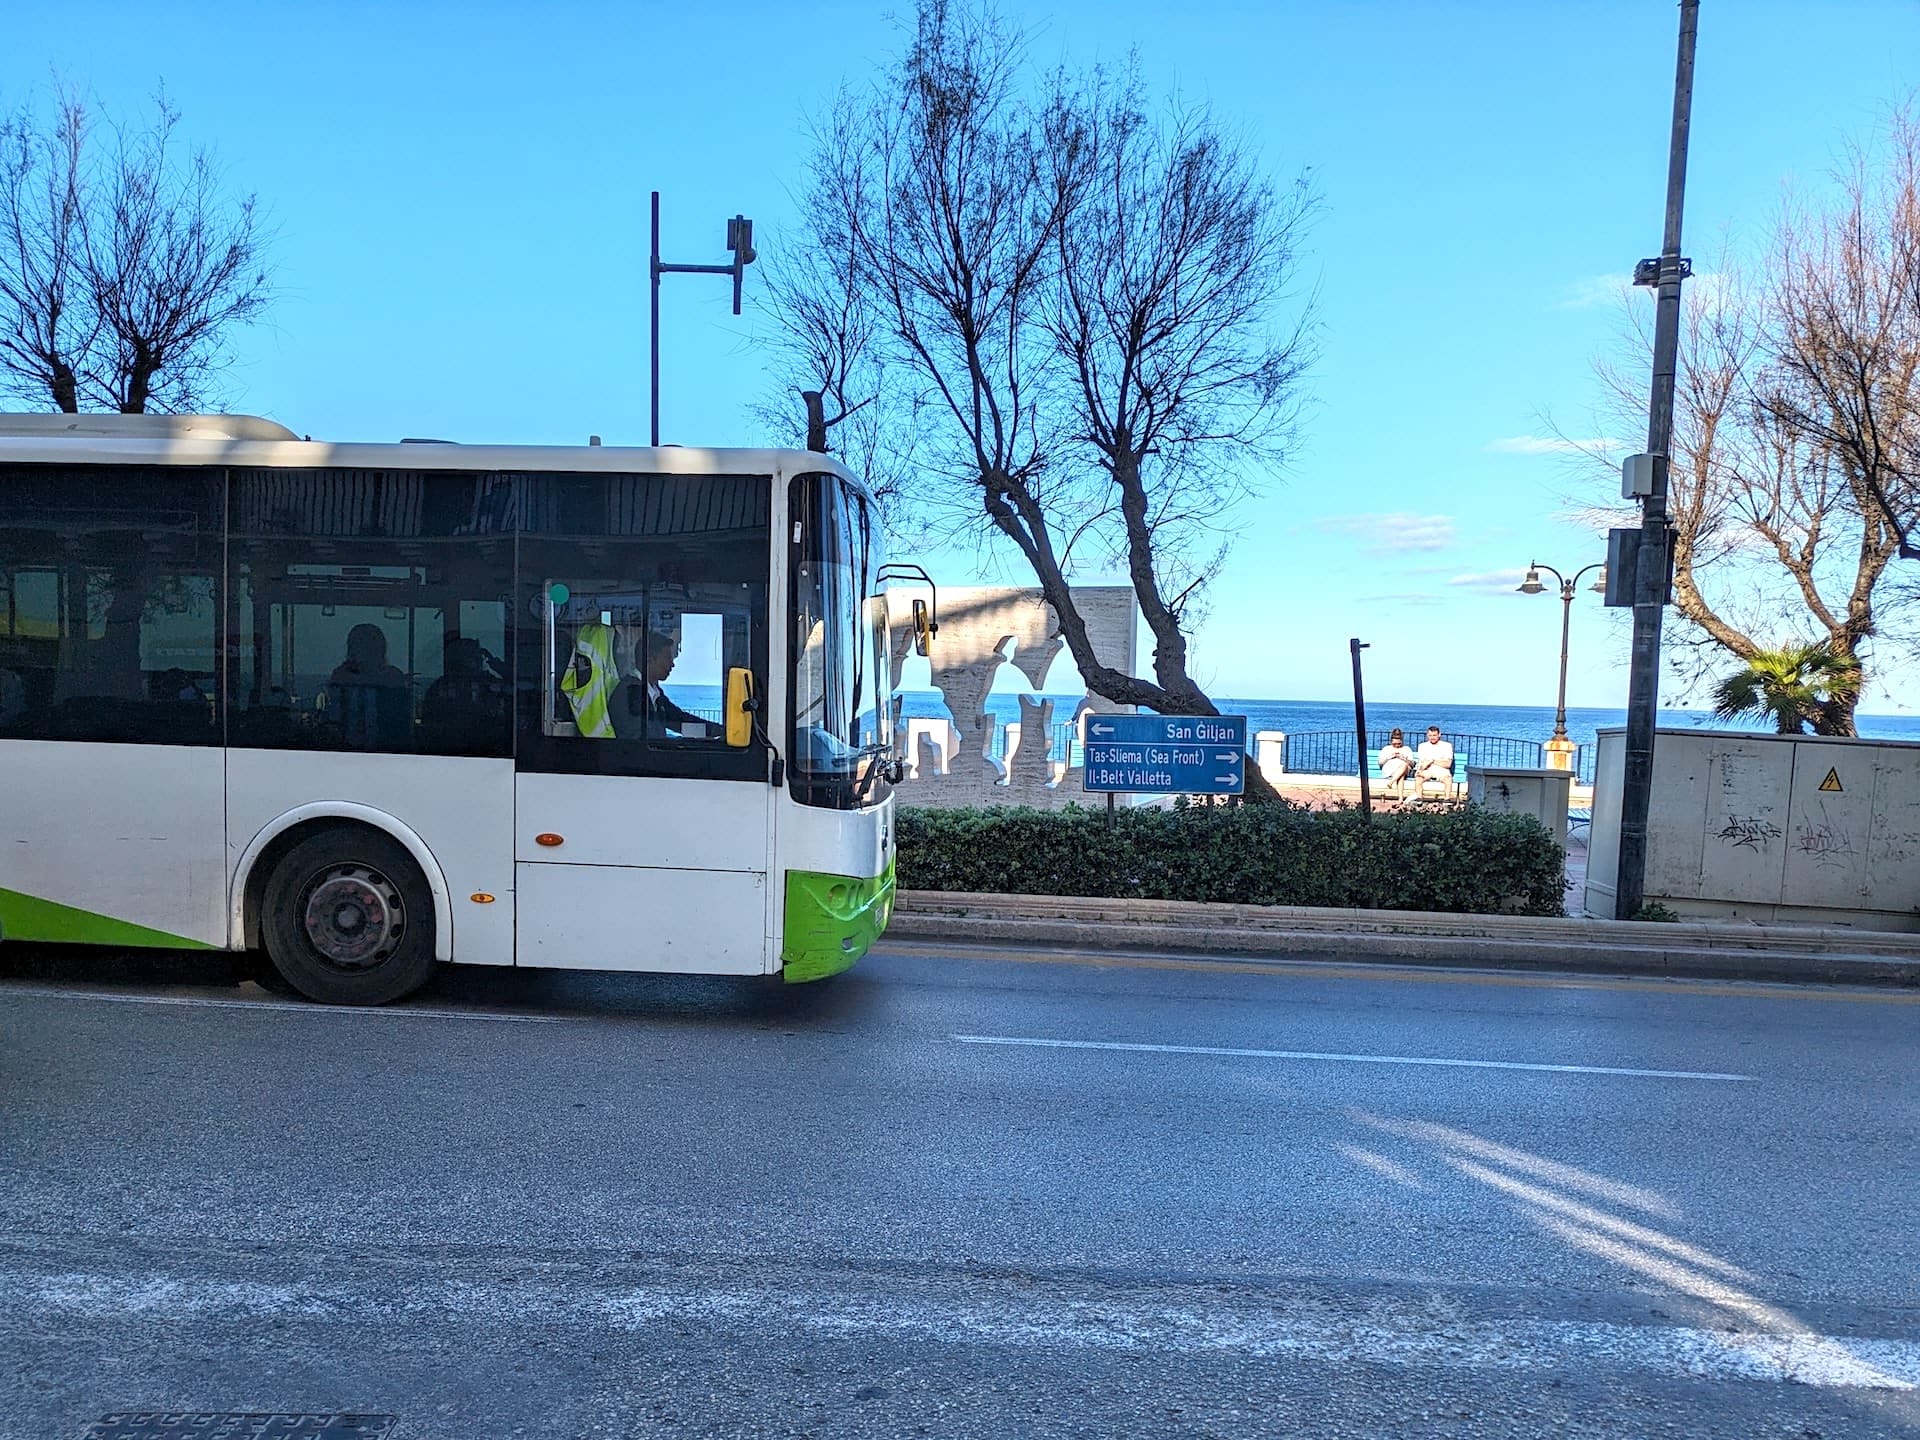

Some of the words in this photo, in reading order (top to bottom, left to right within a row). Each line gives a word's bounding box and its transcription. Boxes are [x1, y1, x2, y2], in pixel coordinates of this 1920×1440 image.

[1167, 723, 1191, 739] San
[1089, 748, 1142, 764] Tas-Sliema
[1145, 748, 1169, 765] (Sea
[1173, 749, 1205, 767] Front)
[1089, 769, 1124, 784] Il-Belt
[1128, 771, 1172, 786] Valletta
